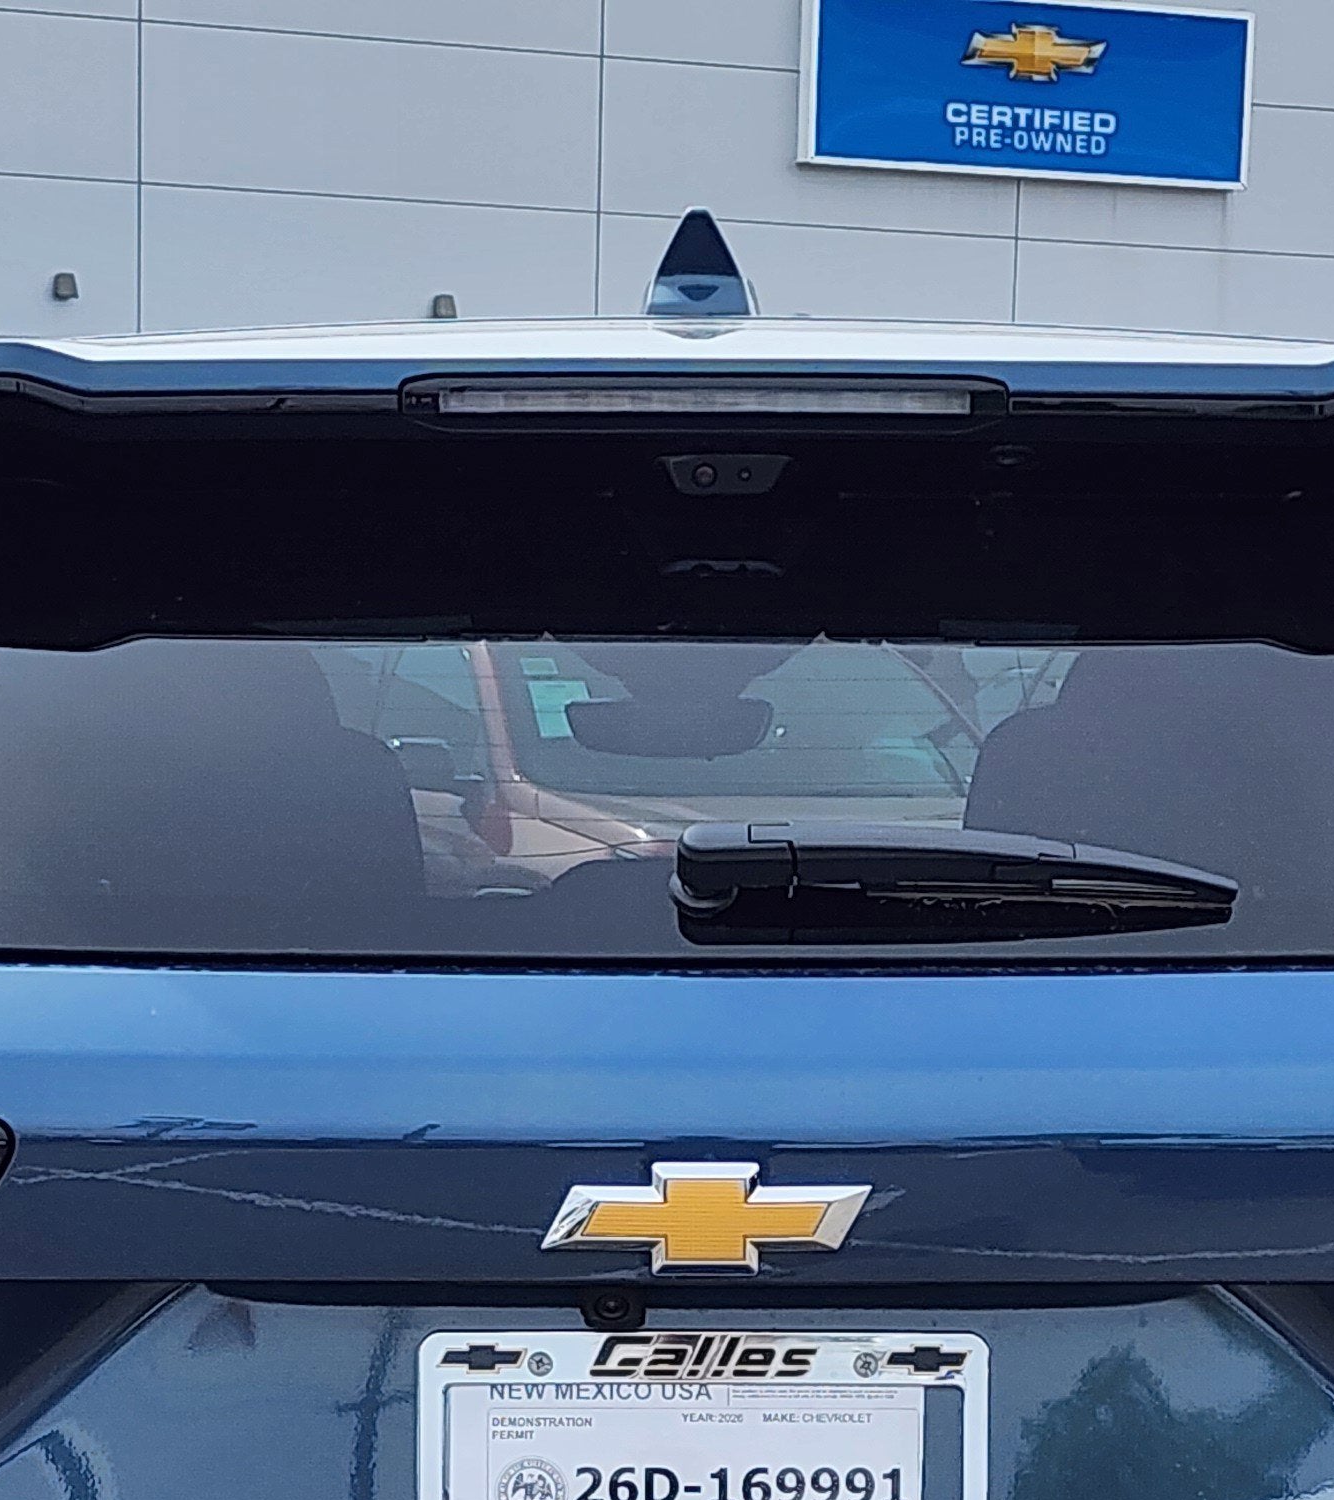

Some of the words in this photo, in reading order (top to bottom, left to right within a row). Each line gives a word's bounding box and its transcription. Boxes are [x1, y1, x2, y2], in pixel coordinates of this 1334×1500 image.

[946, 102, 1117, 134] CERTIFIED
[955, 128, 1106, 156] PRE-OWNED
[589, 1334, 820, 1379] Galles
[489, 1384, 546, 1400] NEW
[554, 1384, 652, 1400] MEXICO
[661, 1384, 713, 1400] USA
[491, 1417, 593, 1427] DEMONSTRATION
[762, 1413, 800, 1423] MAKE:
[802, 1413, 873, 1423] CHEVROLET
[491, 1430, 535, 1440] PERMIT
